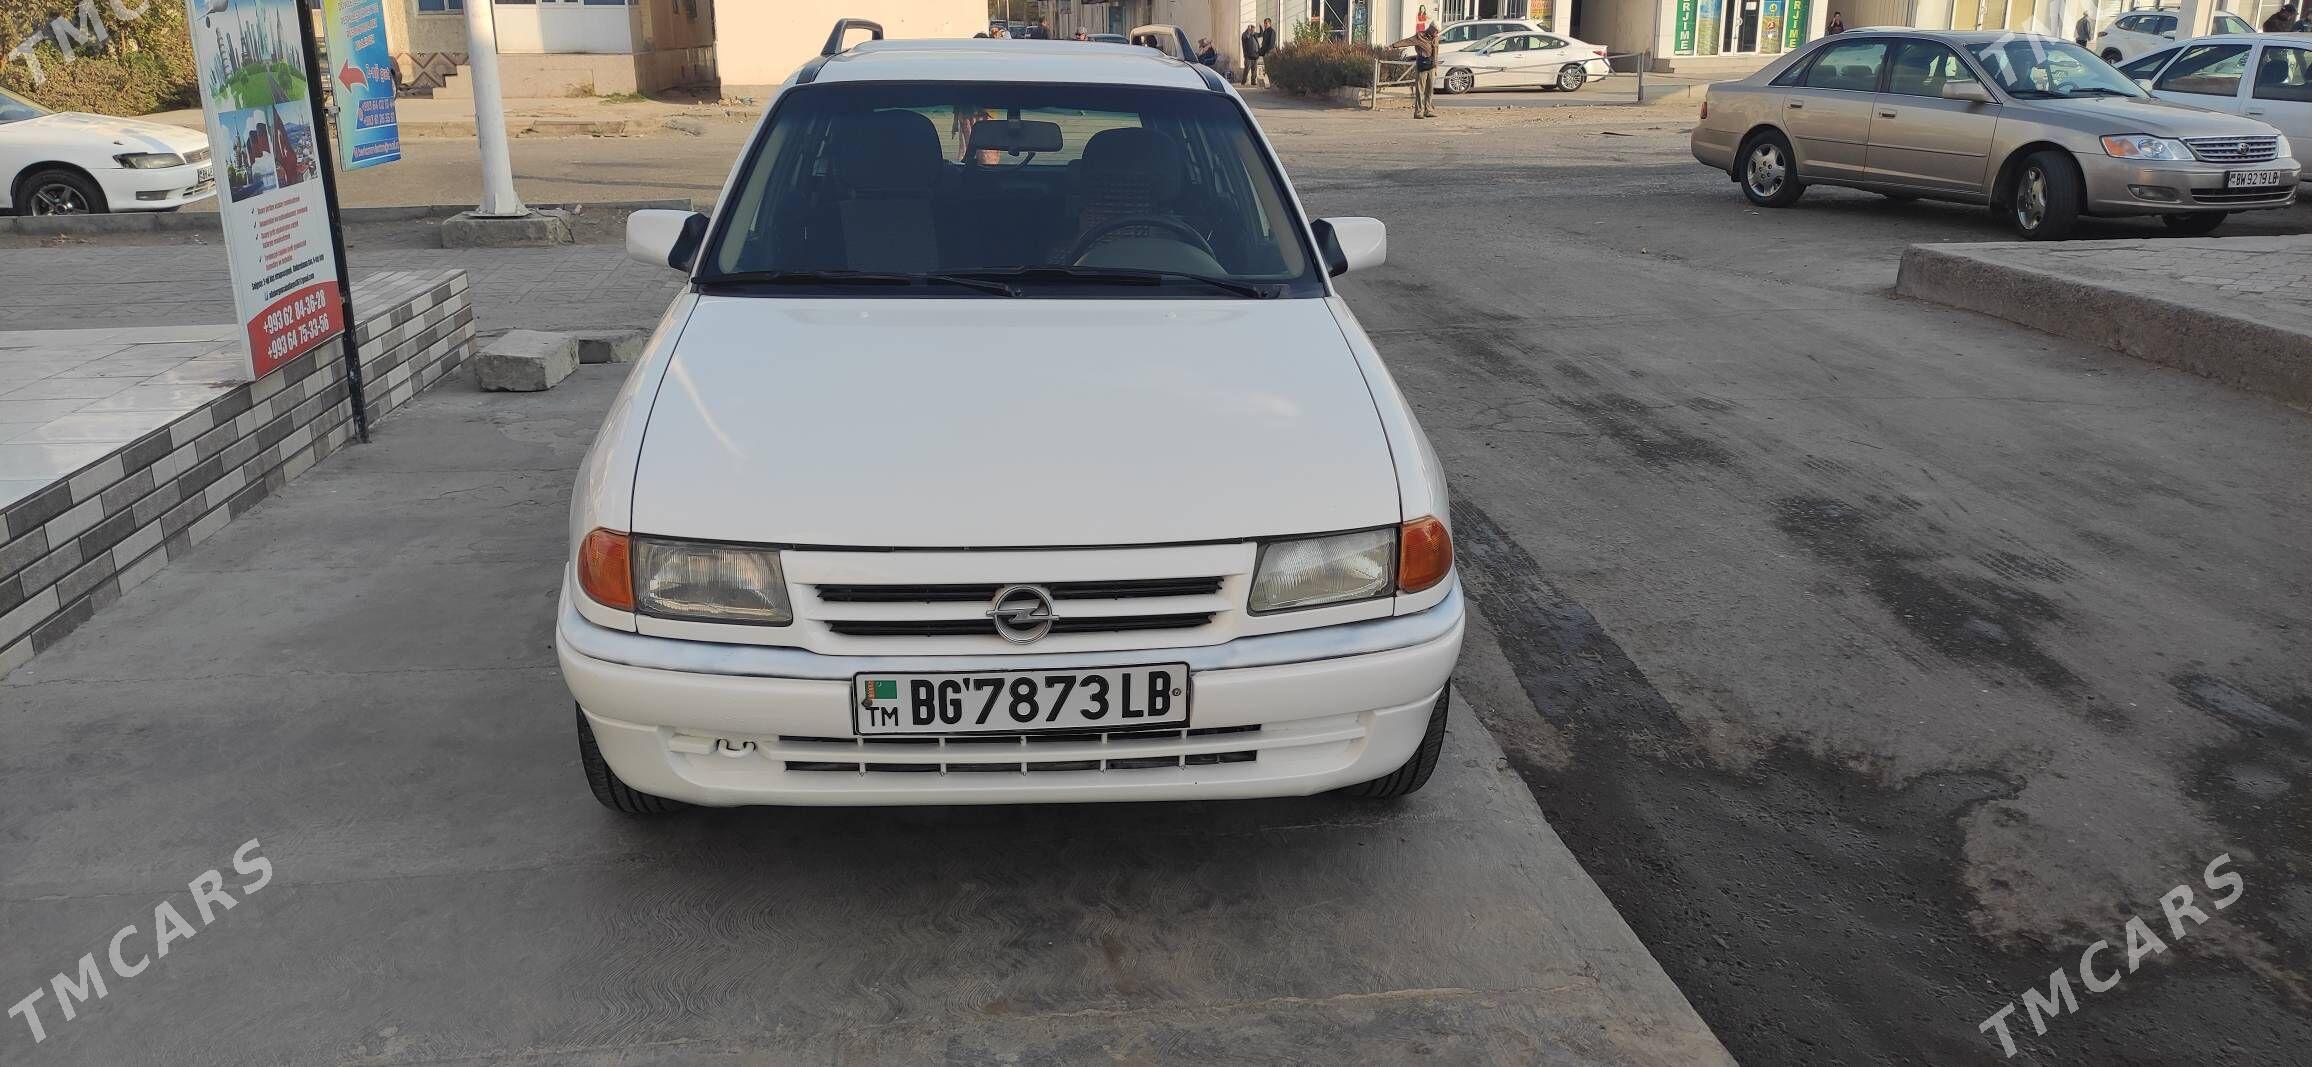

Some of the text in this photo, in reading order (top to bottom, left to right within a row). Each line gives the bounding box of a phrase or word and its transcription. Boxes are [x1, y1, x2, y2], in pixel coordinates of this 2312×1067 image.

[1680, 0, 1691, 49] RJIME
[263, 310, 284, 335] +993
[283, 305, 294, 326] 62
[267, 334, 288, 360] +993
[287, 330, 298, 351] 64
[1122, 671, 1172, 718] LB
[865, 707, 898, 727] TM
